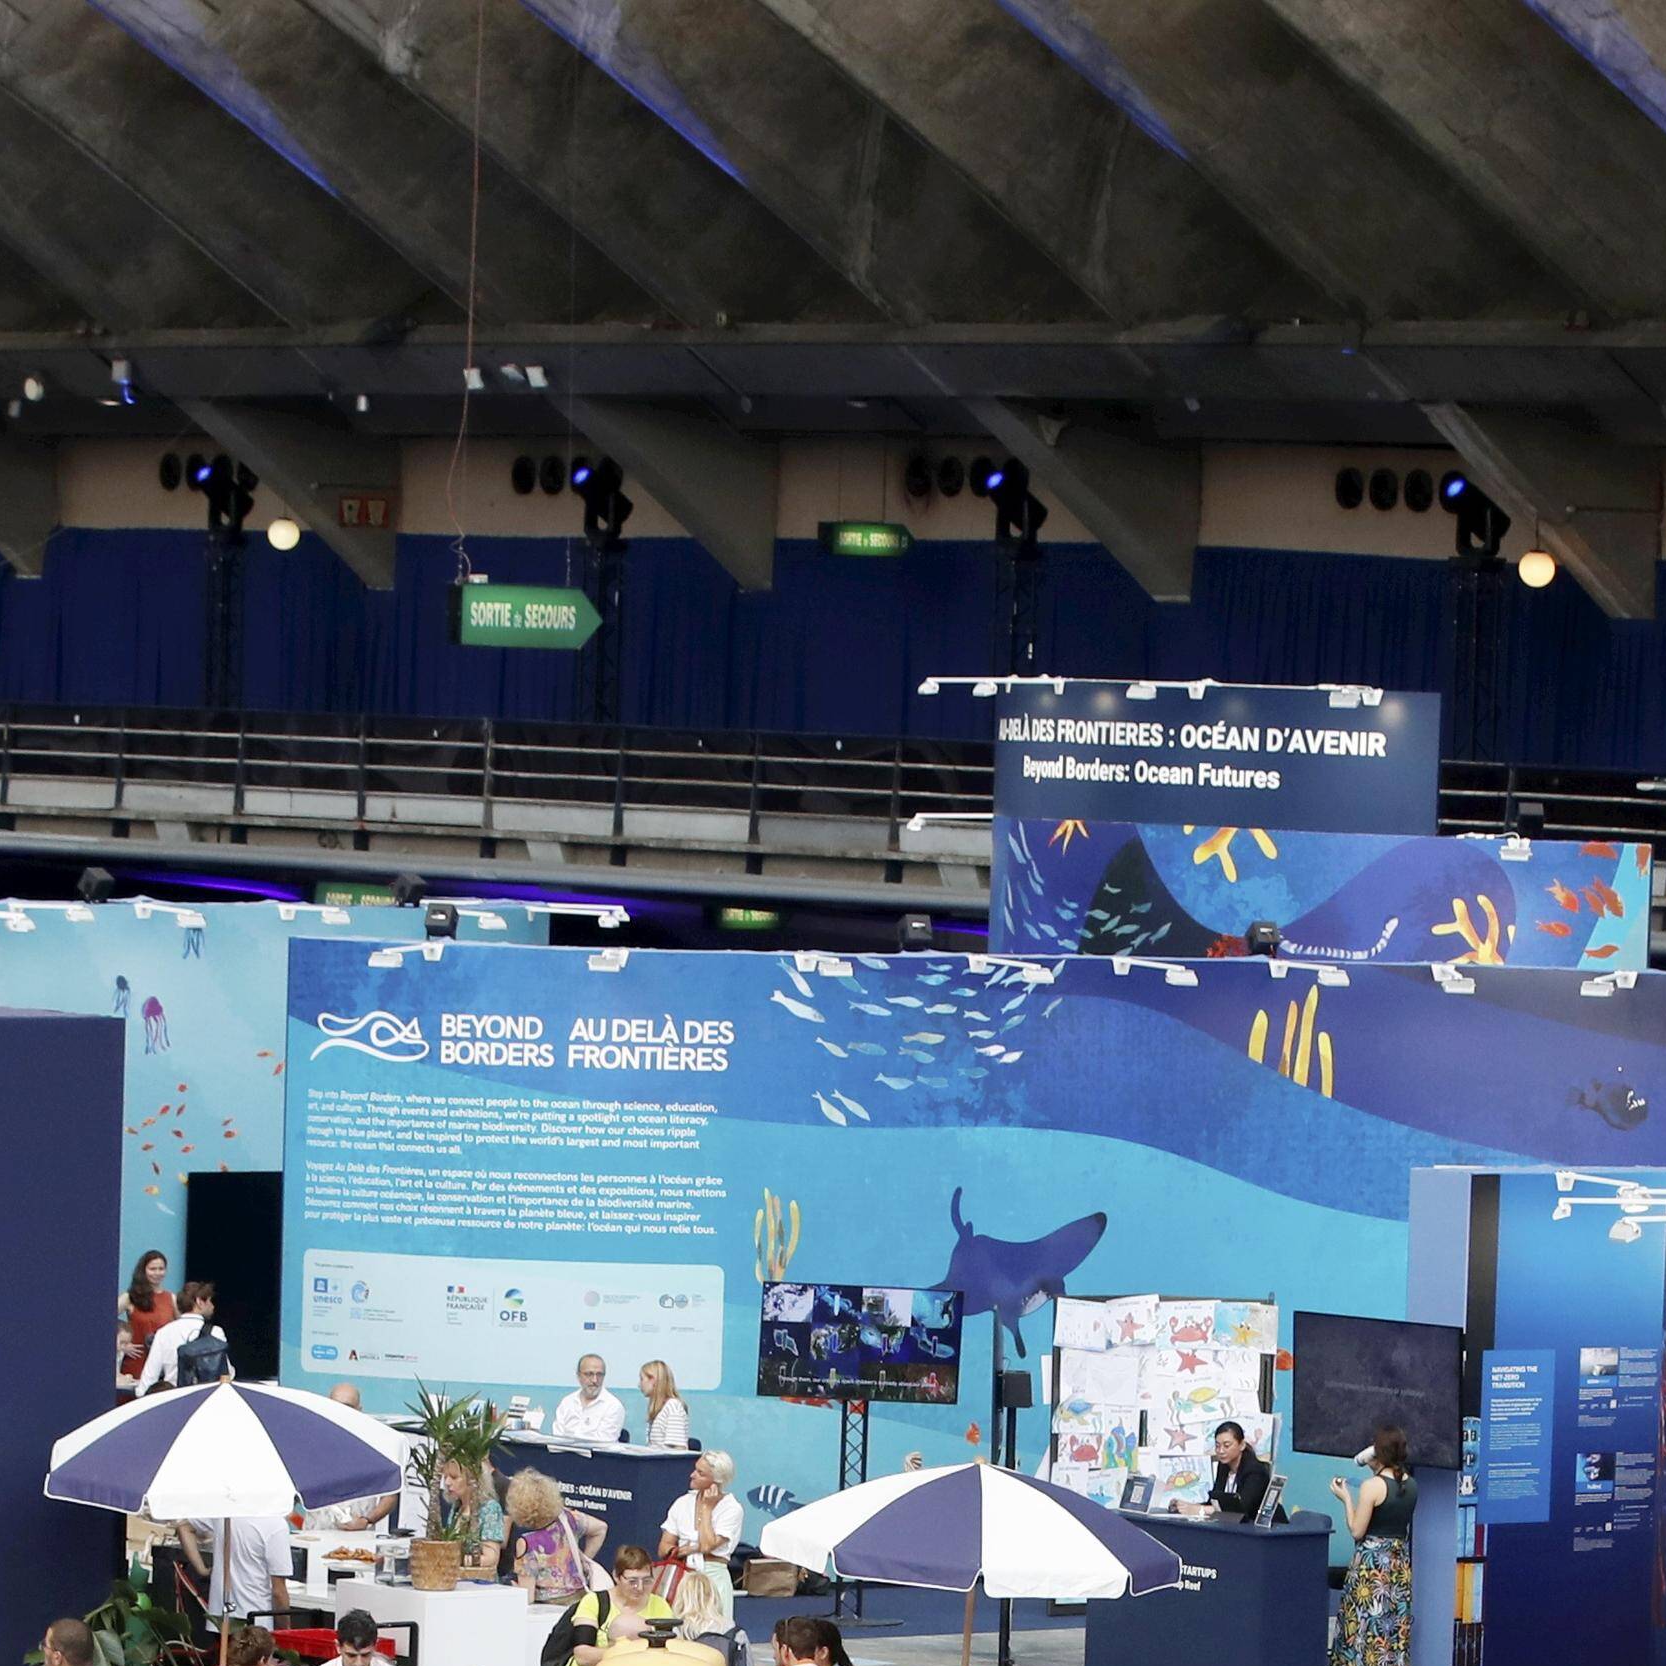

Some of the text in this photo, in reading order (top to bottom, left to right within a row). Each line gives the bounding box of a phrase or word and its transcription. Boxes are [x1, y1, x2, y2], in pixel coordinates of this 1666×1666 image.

[470, 601, 512, 627] SORTIE
[524, 603, 577, 631] SECOURS
[1032, 719, 1055, 743] DES
[1056, 721, 1164, 749] FRONTIERES
[1180, 721, 1259, 752] OCÉAN
[1023, 755, 1280, 790] Beyond Borders: Ocean Futures
[441, 1013, 735, 1046] BEYOND AU DELÀ DES
[440, 1040, 730, 1072] BORDERS FRONTIÈRES
[448, 1096, 484, 1106] connect
[486, 1097, 519, 1109] people
[533, 1098, 548, 1108] the
[551, 1100, 580, 1109] ocean
[582, 1100, 621, 1112] through
[624, 1101, 663, 1112] science,
[665, 1102, 718, 1113] education,
[532, 1111, 567, 1123] putting
[577, 1112, 620, 1125] spotlight
[622, 1115, 635, 1124] on
[638, 1115, 668, 1124] ocean
[670, 1114, 709, 1127] literacy,
[541, 1122, 583, 1134] Discover
[585, 1124, 605, 1135] how
[607, 1126, 625, 1135] our
[627, 1126, 665, 1137] choices
[667, 1127, 697, 1139] ripple
[476, 1134, 700, 1151] protect largest and most important
[597, 1174, 647, 1185] personnes
[695, 1175, 723, 1187] grâce
[660, 1188, 684, 1197] nous
[597, 1198, 654, 1209] biodiversité
[663, 1212, 701, 1223] inspirer
[518, 1221, 543, 1231] notre
[624, 1223, 641, 1235] qui
[643, 1224, 668, 1233] nous
[669, 1224, 691, 1234] relie
[693, 1224, 718, 1235] tous.
[499, 1310, 528, 1322] OFB
